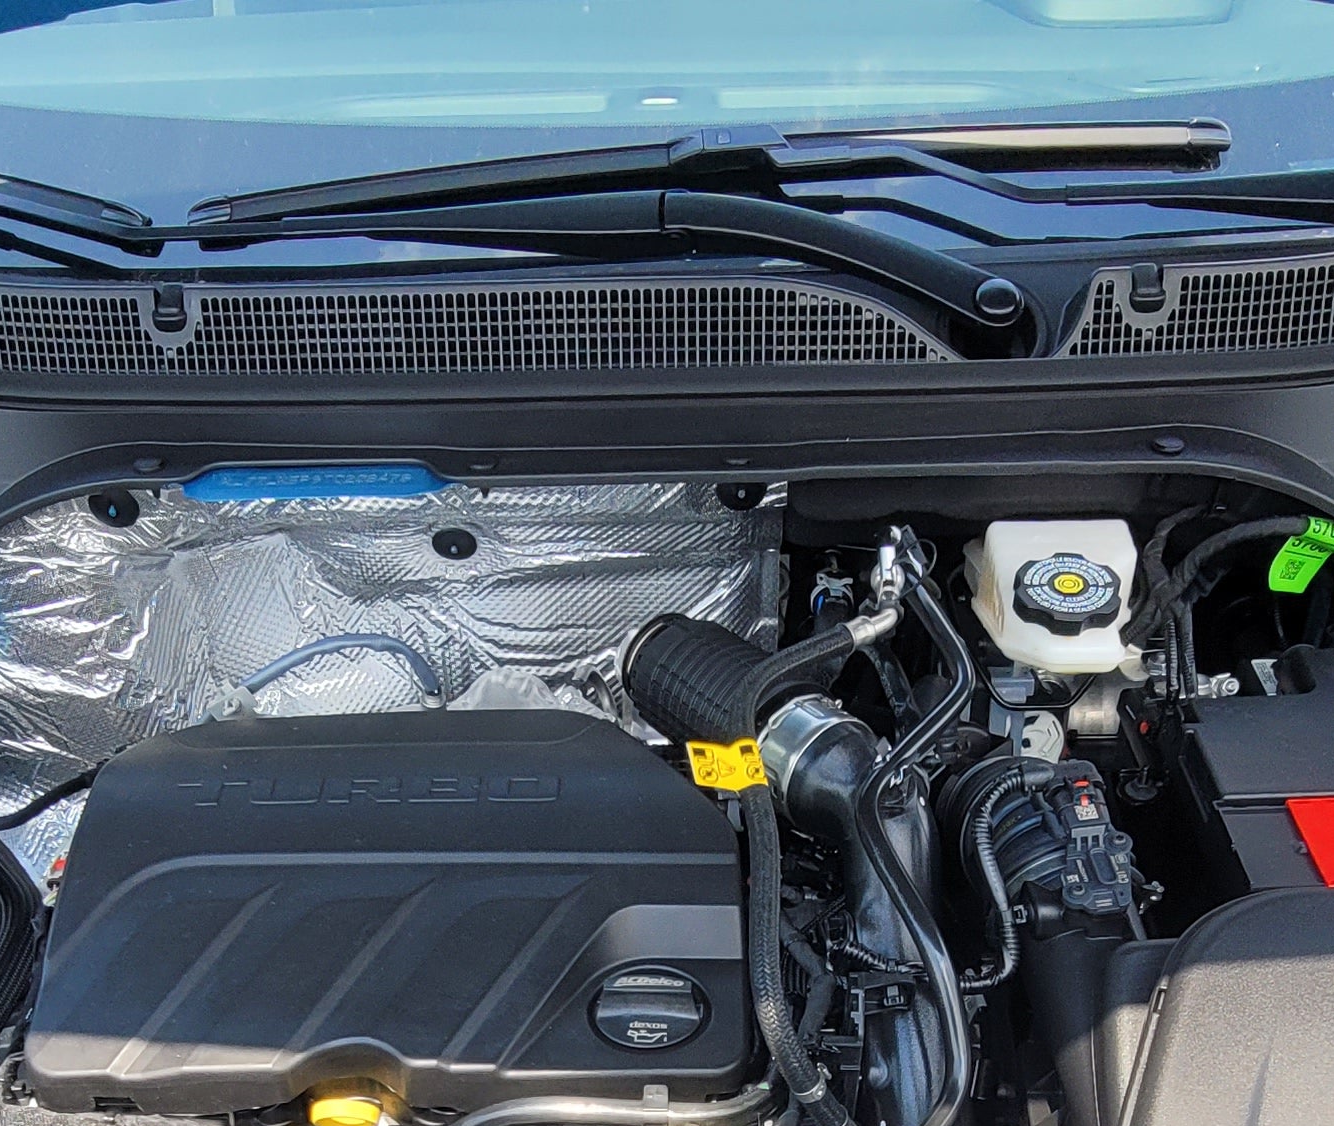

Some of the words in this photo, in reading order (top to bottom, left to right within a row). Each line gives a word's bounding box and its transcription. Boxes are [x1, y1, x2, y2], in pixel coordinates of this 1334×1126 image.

[177, 775, 562, 807] TURBO
[613, 976, 685, 987] ACDelco
[629, 1020, 668, 1029] dexos
